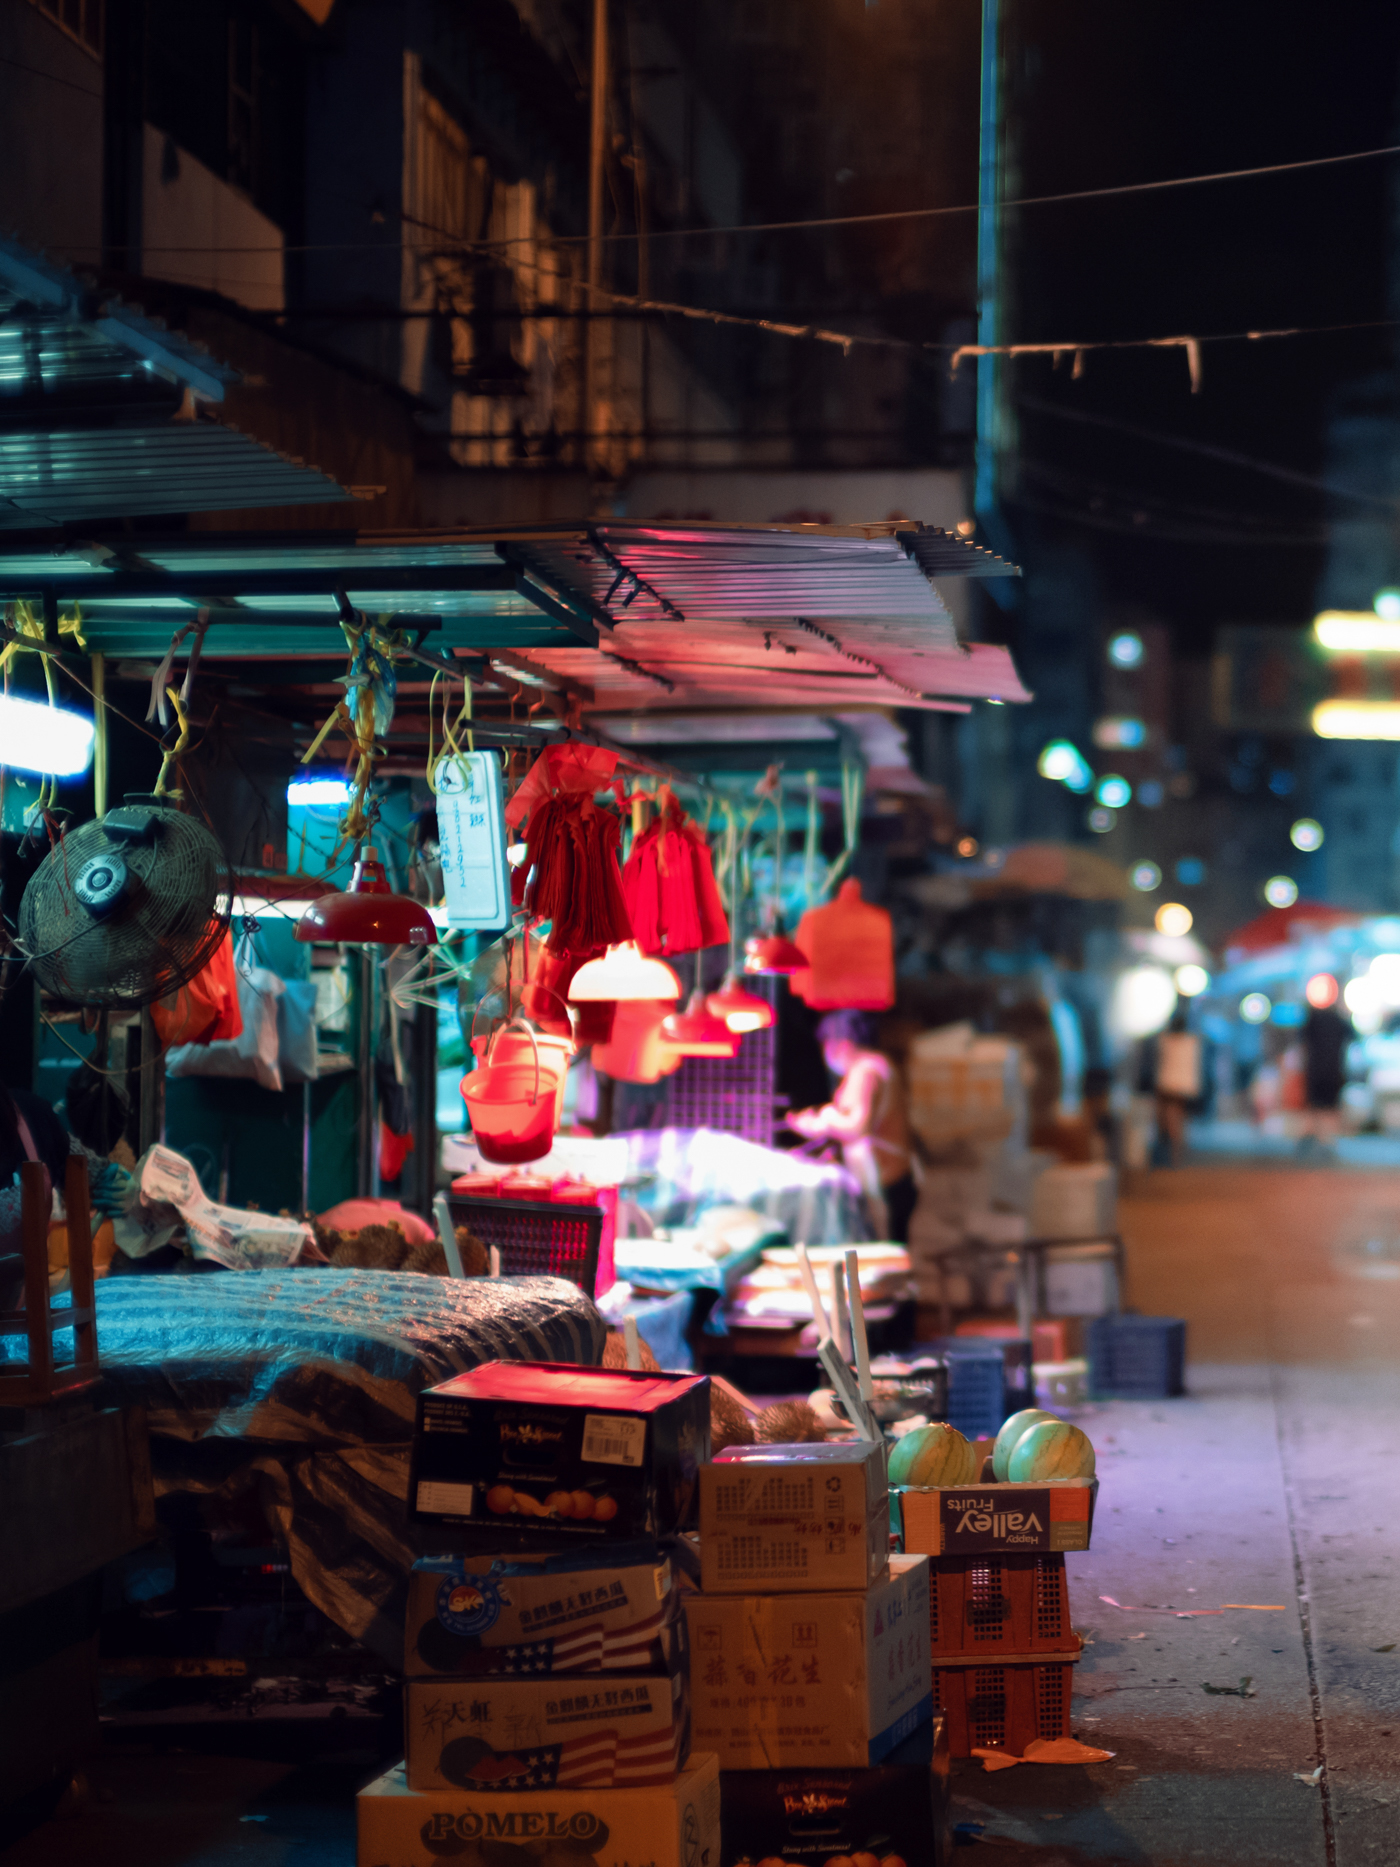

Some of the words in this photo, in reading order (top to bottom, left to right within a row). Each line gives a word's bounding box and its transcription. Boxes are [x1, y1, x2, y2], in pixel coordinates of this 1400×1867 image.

[947, 1499, 994, 1512] Fruits
[1006, 1535, 1039, 1545] Happy
[1061, 1538, 1083, 1546] CLASS
[452, 1595, 480, 1613] SK
[444, 1699, 494, 1724] 天虹
[430, 1809, 599, 1840] POMELO
